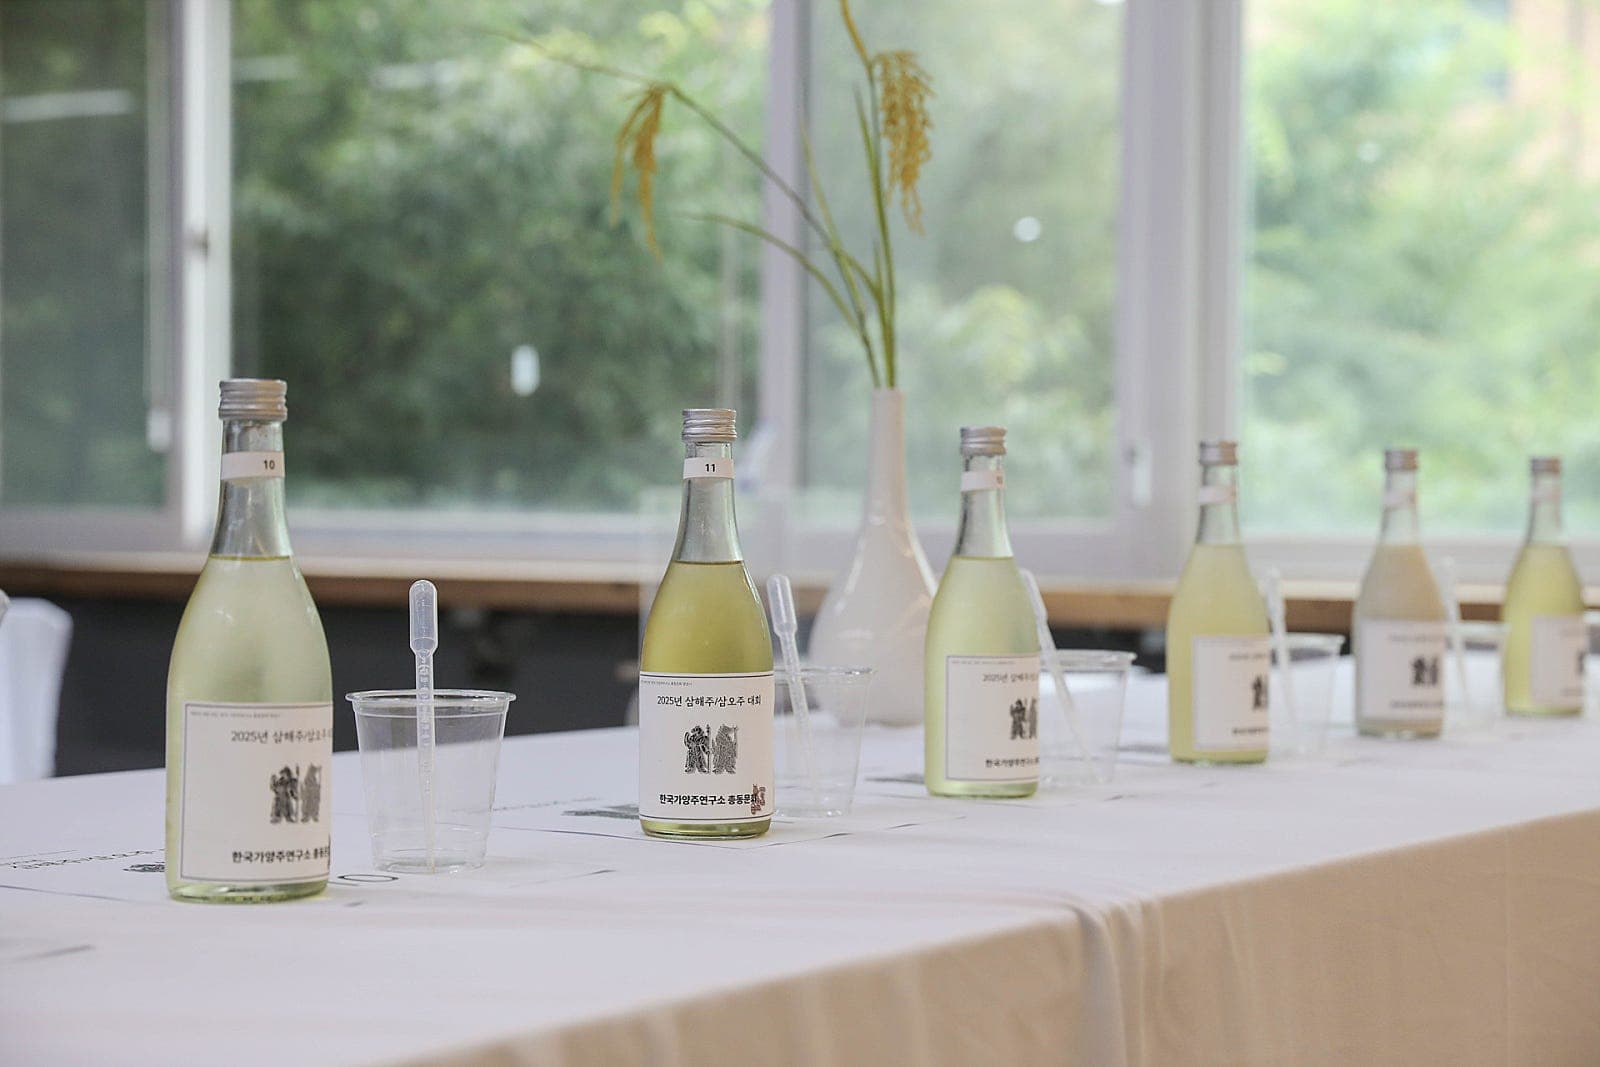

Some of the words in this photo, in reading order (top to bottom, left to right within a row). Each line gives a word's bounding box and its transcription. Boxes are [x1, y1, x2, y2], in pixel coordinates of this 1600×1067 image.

[263, 459, 276, 470] 10
[705, 463, 716, 473] 11
[657, 695, 683, 707] 2025년
[685, 695, 745, 708] 삼해주/삼오주
[747, 694, 762, 706] 대회
[231, 729, 268, 745] 2025년
[659, 793, 726, 806] 한국가양주연구소
[232, 848, 312, 864] 한국가양주연구소
